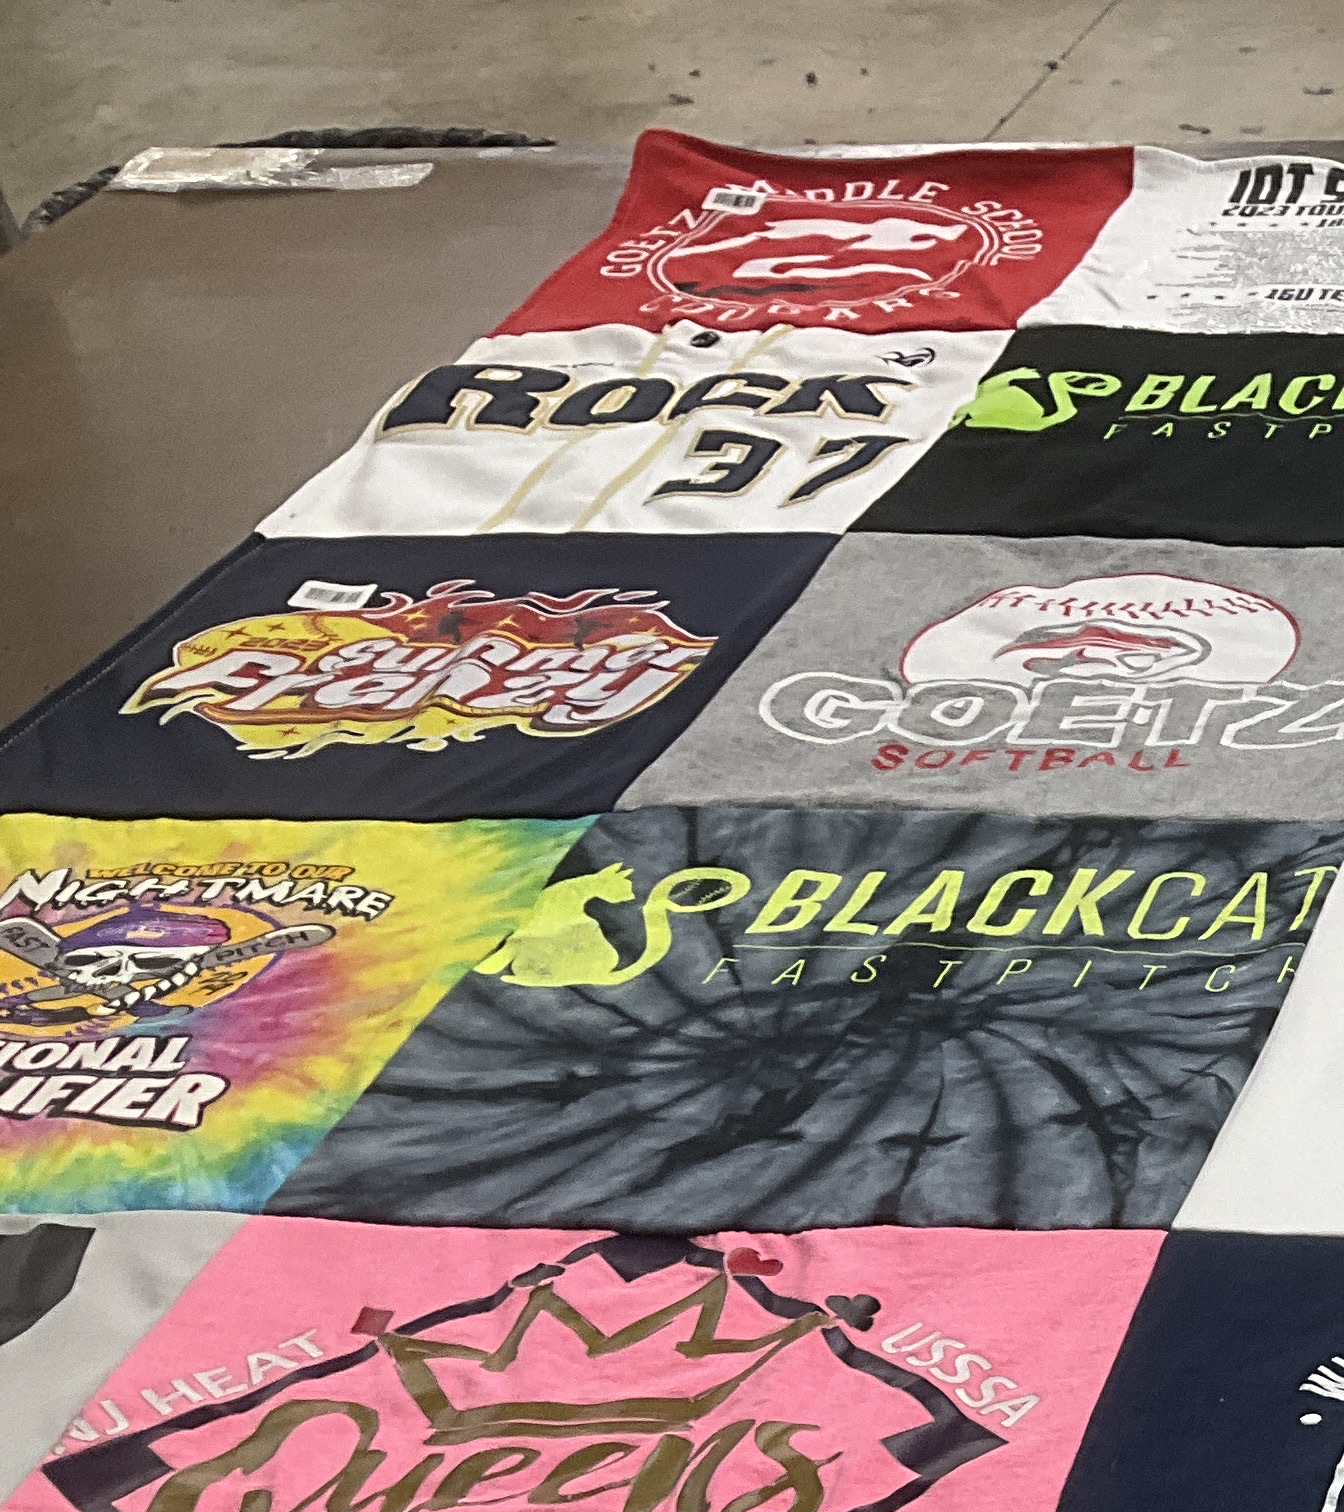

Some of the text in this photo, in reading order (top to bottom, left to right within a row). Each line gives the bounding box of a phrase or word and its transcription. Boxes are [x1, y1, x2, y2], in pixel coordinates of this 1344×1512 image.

[1222, 203, 1287, 217] 2023
[1229, 163, 1314, 205] IDT
[600, 208, 704, 278] GOETZ
[960, 199, 1043, 267] SCHOOL
[1264, 287, 1316, 302] 16U
[374, 362, 918, 447] ROCK
[643, 428, 916, 508] 37
[870, 743, 1192, 773] SOFTBALL
[0, 867, 396, 921] NIGHTMARE
[85, 861, 357, 881] WELCOME TO OUR
[214, 930, 310, 963] PITCH
[0, 1073, 229, 1127] IFIER
[140, 1328, 325, 1416] HEAT
[878, 1320, 1043, 1431] USSSA
